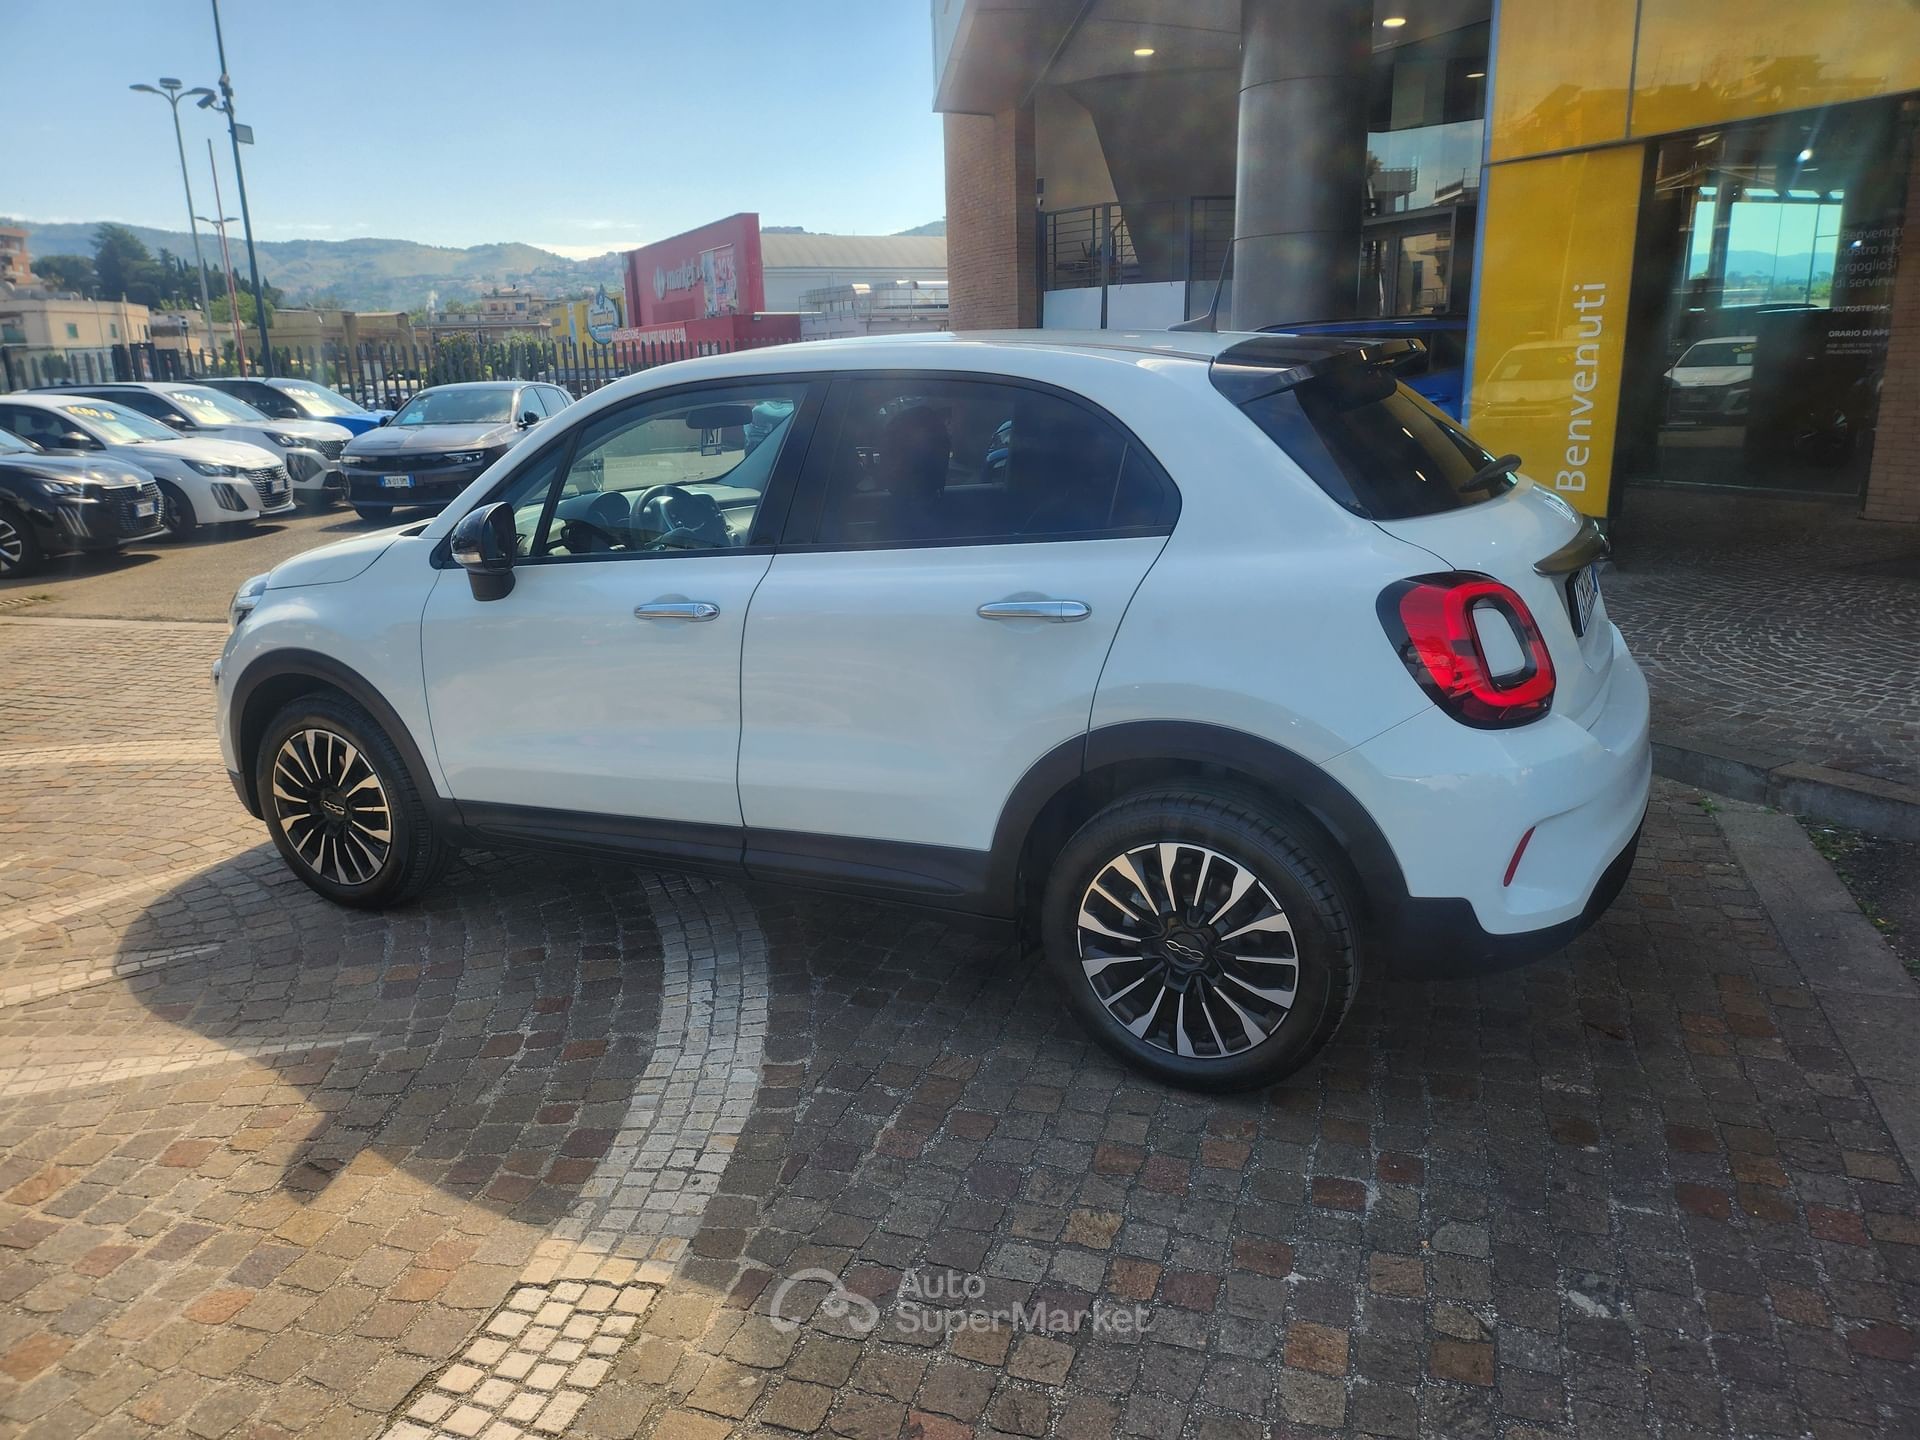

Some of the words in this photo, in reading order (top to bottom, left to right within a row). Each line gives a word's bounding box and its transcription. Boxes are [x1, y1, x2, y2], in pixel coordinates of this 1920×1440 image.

[1556, 283, 1606, 492] Benvenuti
[1828, 329, 1861, 338] ORARIO
[1861, 329, 1872, 337] DI
